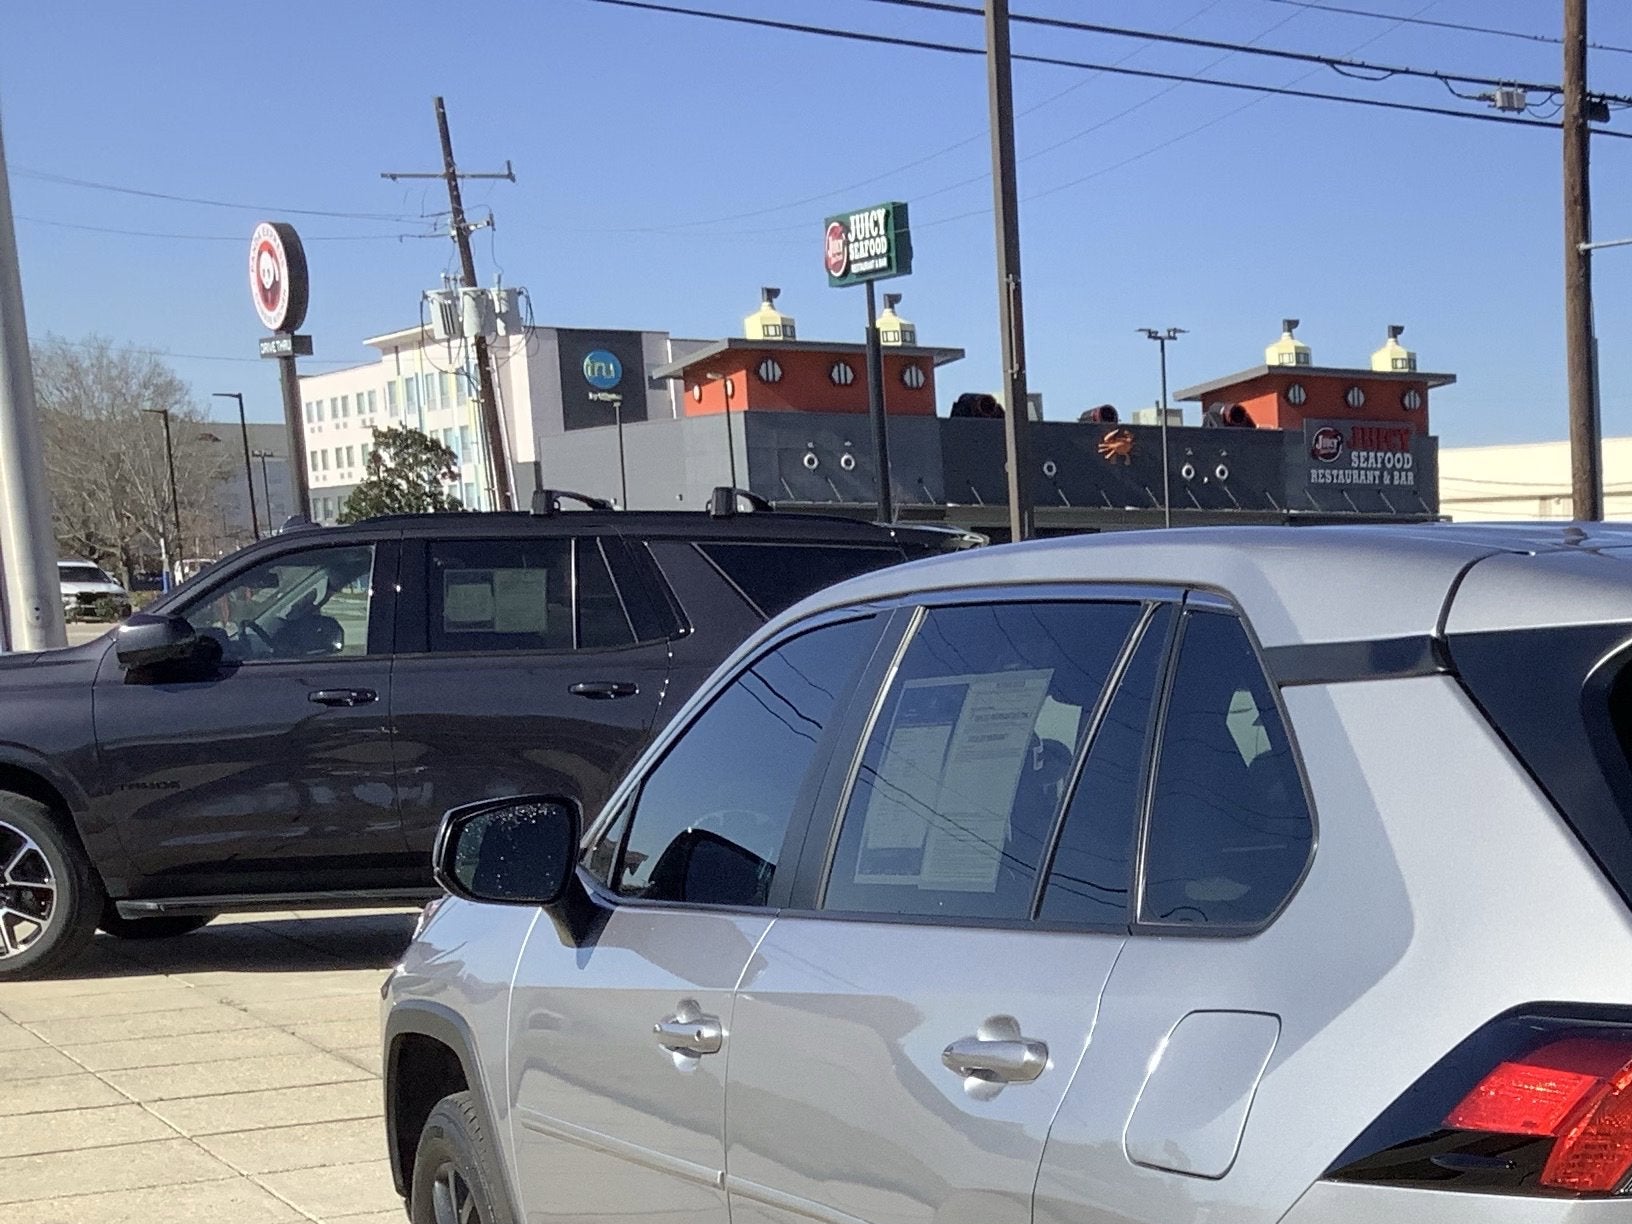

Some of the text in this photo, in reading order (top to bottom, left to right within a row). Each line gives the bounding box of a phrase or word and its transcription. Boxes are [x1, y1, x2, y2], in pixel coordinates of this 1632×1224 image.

[848, 208, 886, 242] JUICY
[849, 236, 888, 261] SEAFOOD
[1350, 451, 1413, 469] SEAFOOD
[1310, 469, 1414, 486] RESTAURANT & BAR
